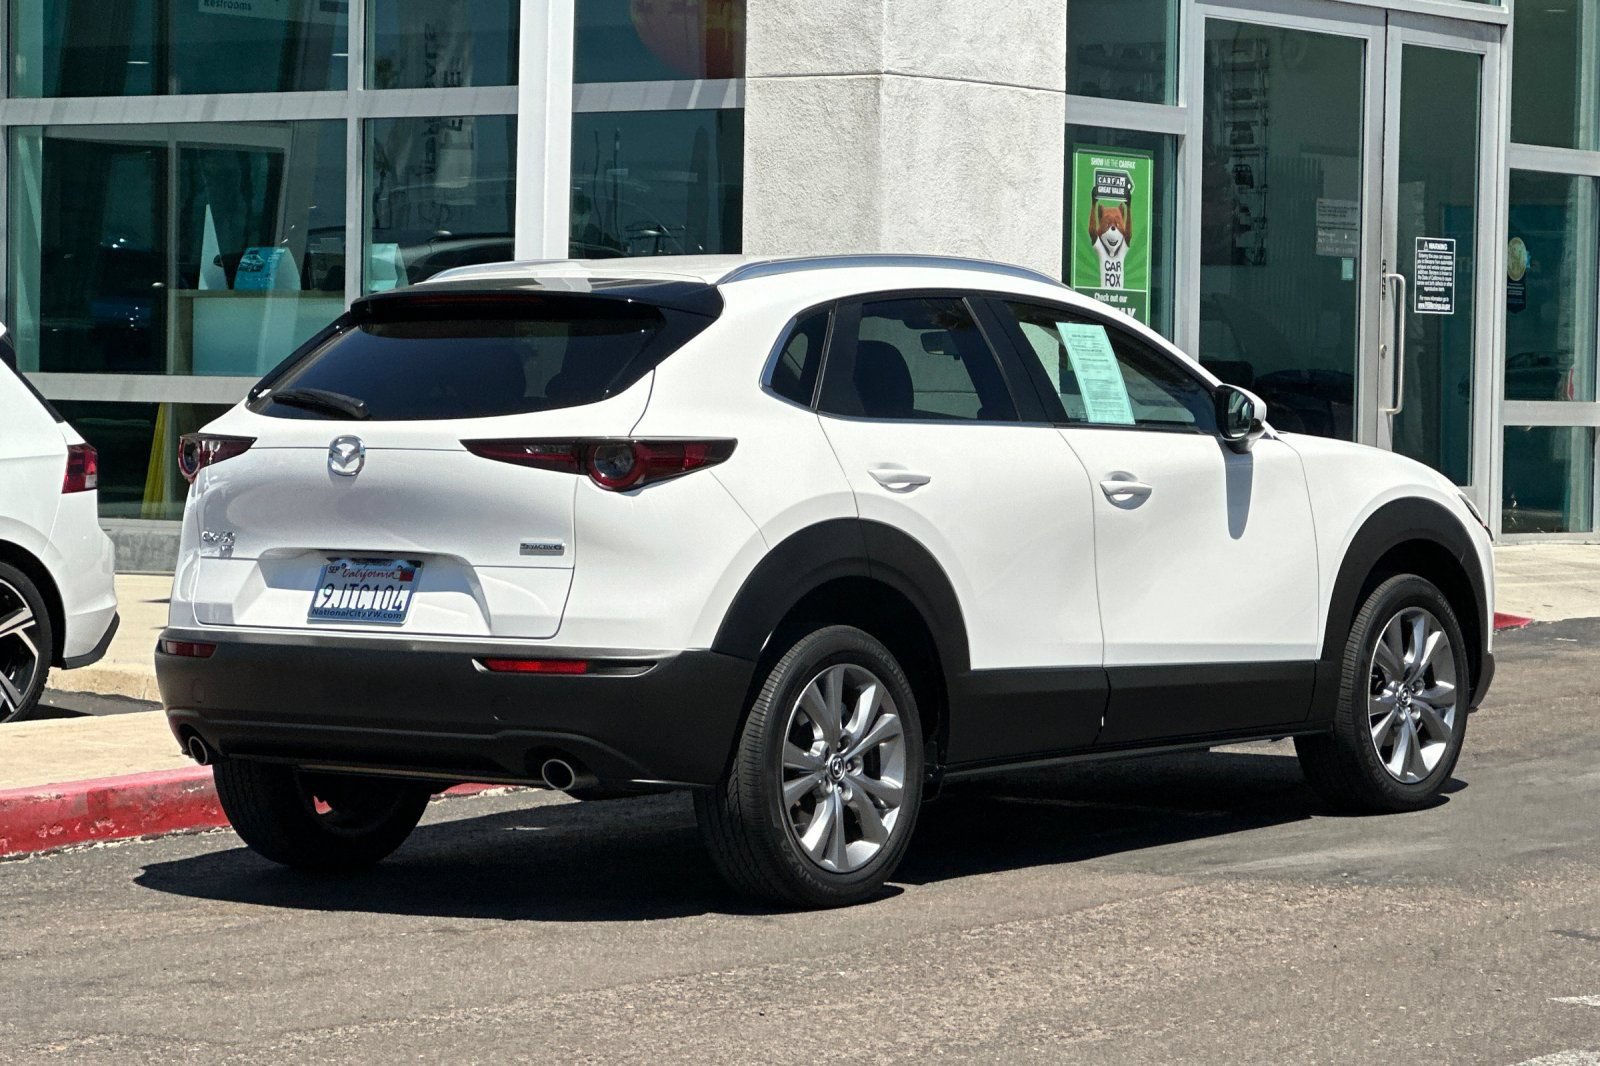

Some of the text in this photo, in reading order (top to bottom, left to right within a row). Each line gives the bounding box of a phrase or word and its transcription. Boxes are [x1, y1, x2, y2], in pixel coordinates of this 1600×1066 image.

[204, 0, 252, 11] Restrooms
[1091, 158, 1103, 166] SHOW
[1110, 160, 1118, 168] THE
[1119, 160, 1136, 169] CARFAX
[1098, 176, 1125, 187] CARFAX
[1098, 186, 1125, 195] GREAT VALUE
[1104, 260, 1121, 272] CAR
[1105, 273, 1121, 288] FOX
[1094, 292, 1128, 303] Check out our
[327, 565, 340, 574] SEP
[342, 567, 395, 582] California
[320, 582, 404, 612] 9JTC104
[312, 608, 402, 620] NationalCityVW.com
[849, 637, 913, 699] RIDGESTON
